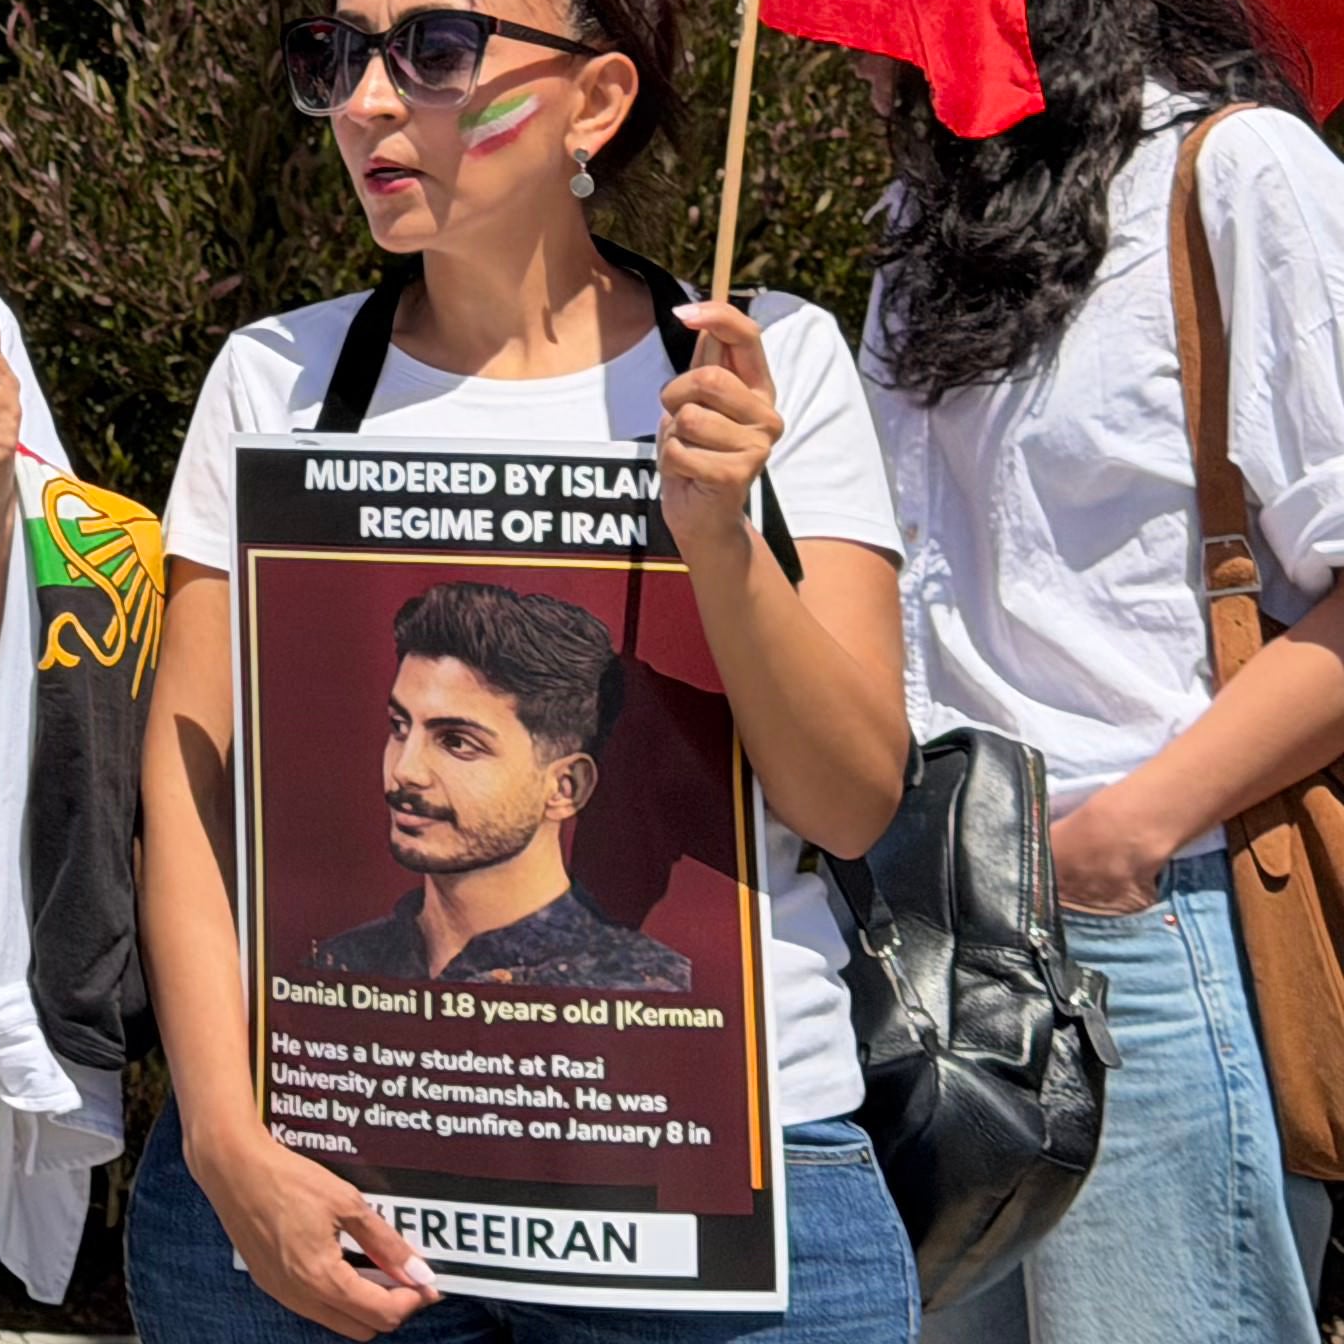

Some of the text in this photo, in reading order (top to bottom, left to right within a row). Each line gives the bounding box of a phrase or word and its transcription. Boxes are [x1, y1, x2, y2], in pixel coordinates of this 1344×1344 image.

[304, 458, 662, 501] MURDERED BY ISLAM
[360, 506, 648, 547] REGIME OF IRAN
[272, 976, 347, 1008] Danial
[352, 984, 417, 1014] Diani
[440, 992, 475, 1018] 18
[481, 999, 557, 1025] years
[563, 999, 608, 1024] old
[271, 1032, 605, 1079] He was a law student at Razi
[271, 1062, 668, 1113] University of Kermanshah. He was
[270, 1091, 711, 1148] killed by direct gunfire on January 8 in
[270, 1122, 358, 1154] Kerman.
[368, 1202, 638, 1263] FREEIRAN
